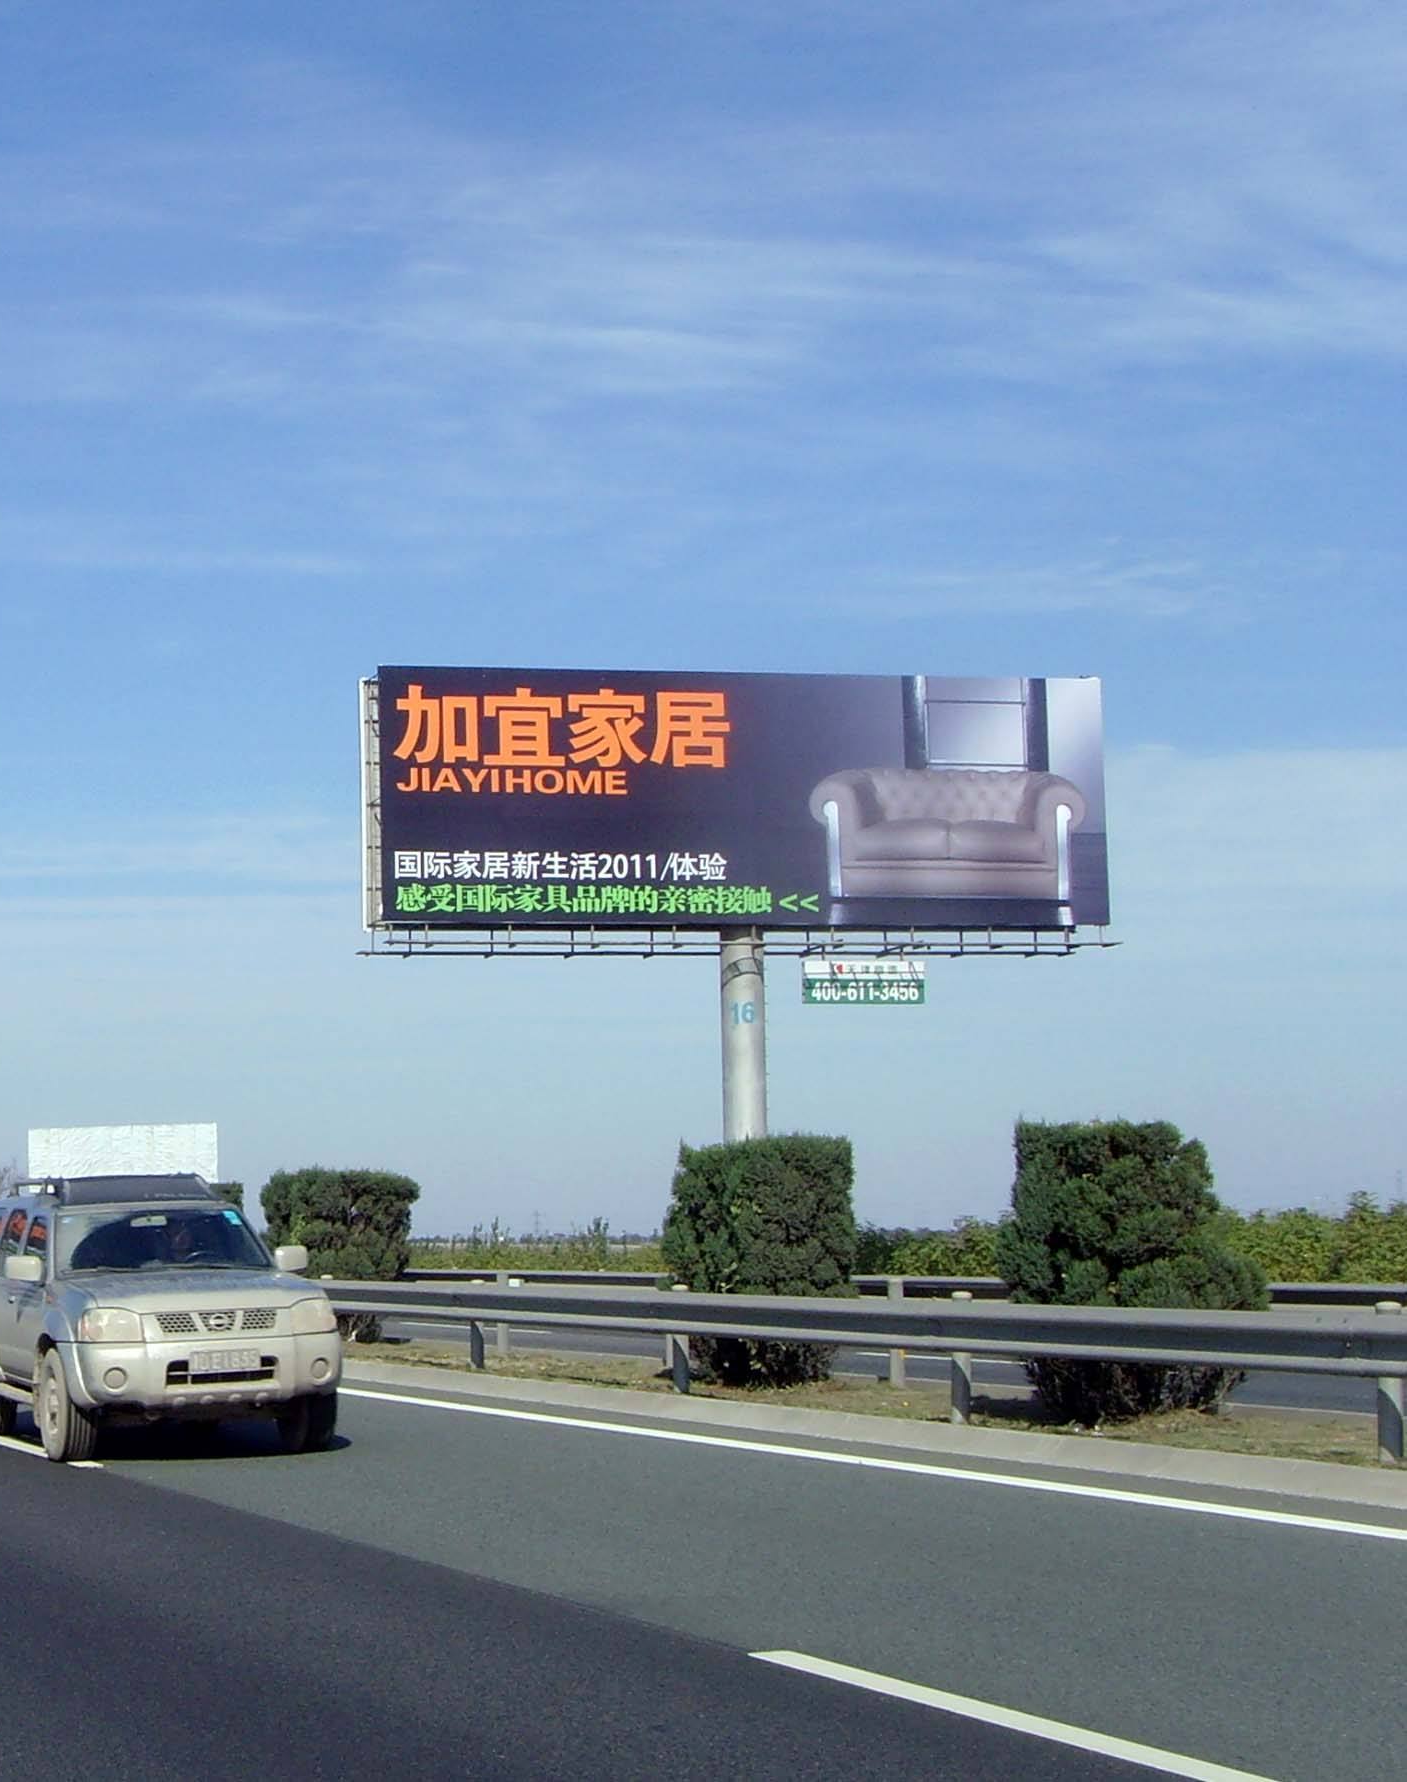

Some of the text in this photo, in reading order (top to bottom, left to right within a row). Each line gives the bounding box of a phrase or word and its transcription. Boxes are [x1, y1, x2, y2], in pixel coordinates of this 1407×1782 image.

[394, 684, 730, 768] 加宜家居
[397, 767, 628, 795] JIAYIHOME
[394, 850, 727, 881] 国际家居新生活2011/体验
[396, 883, 772, 914] 感受国际家具品牌的亲密接触
[811, 982, 919, 1001] 400-611-3456
